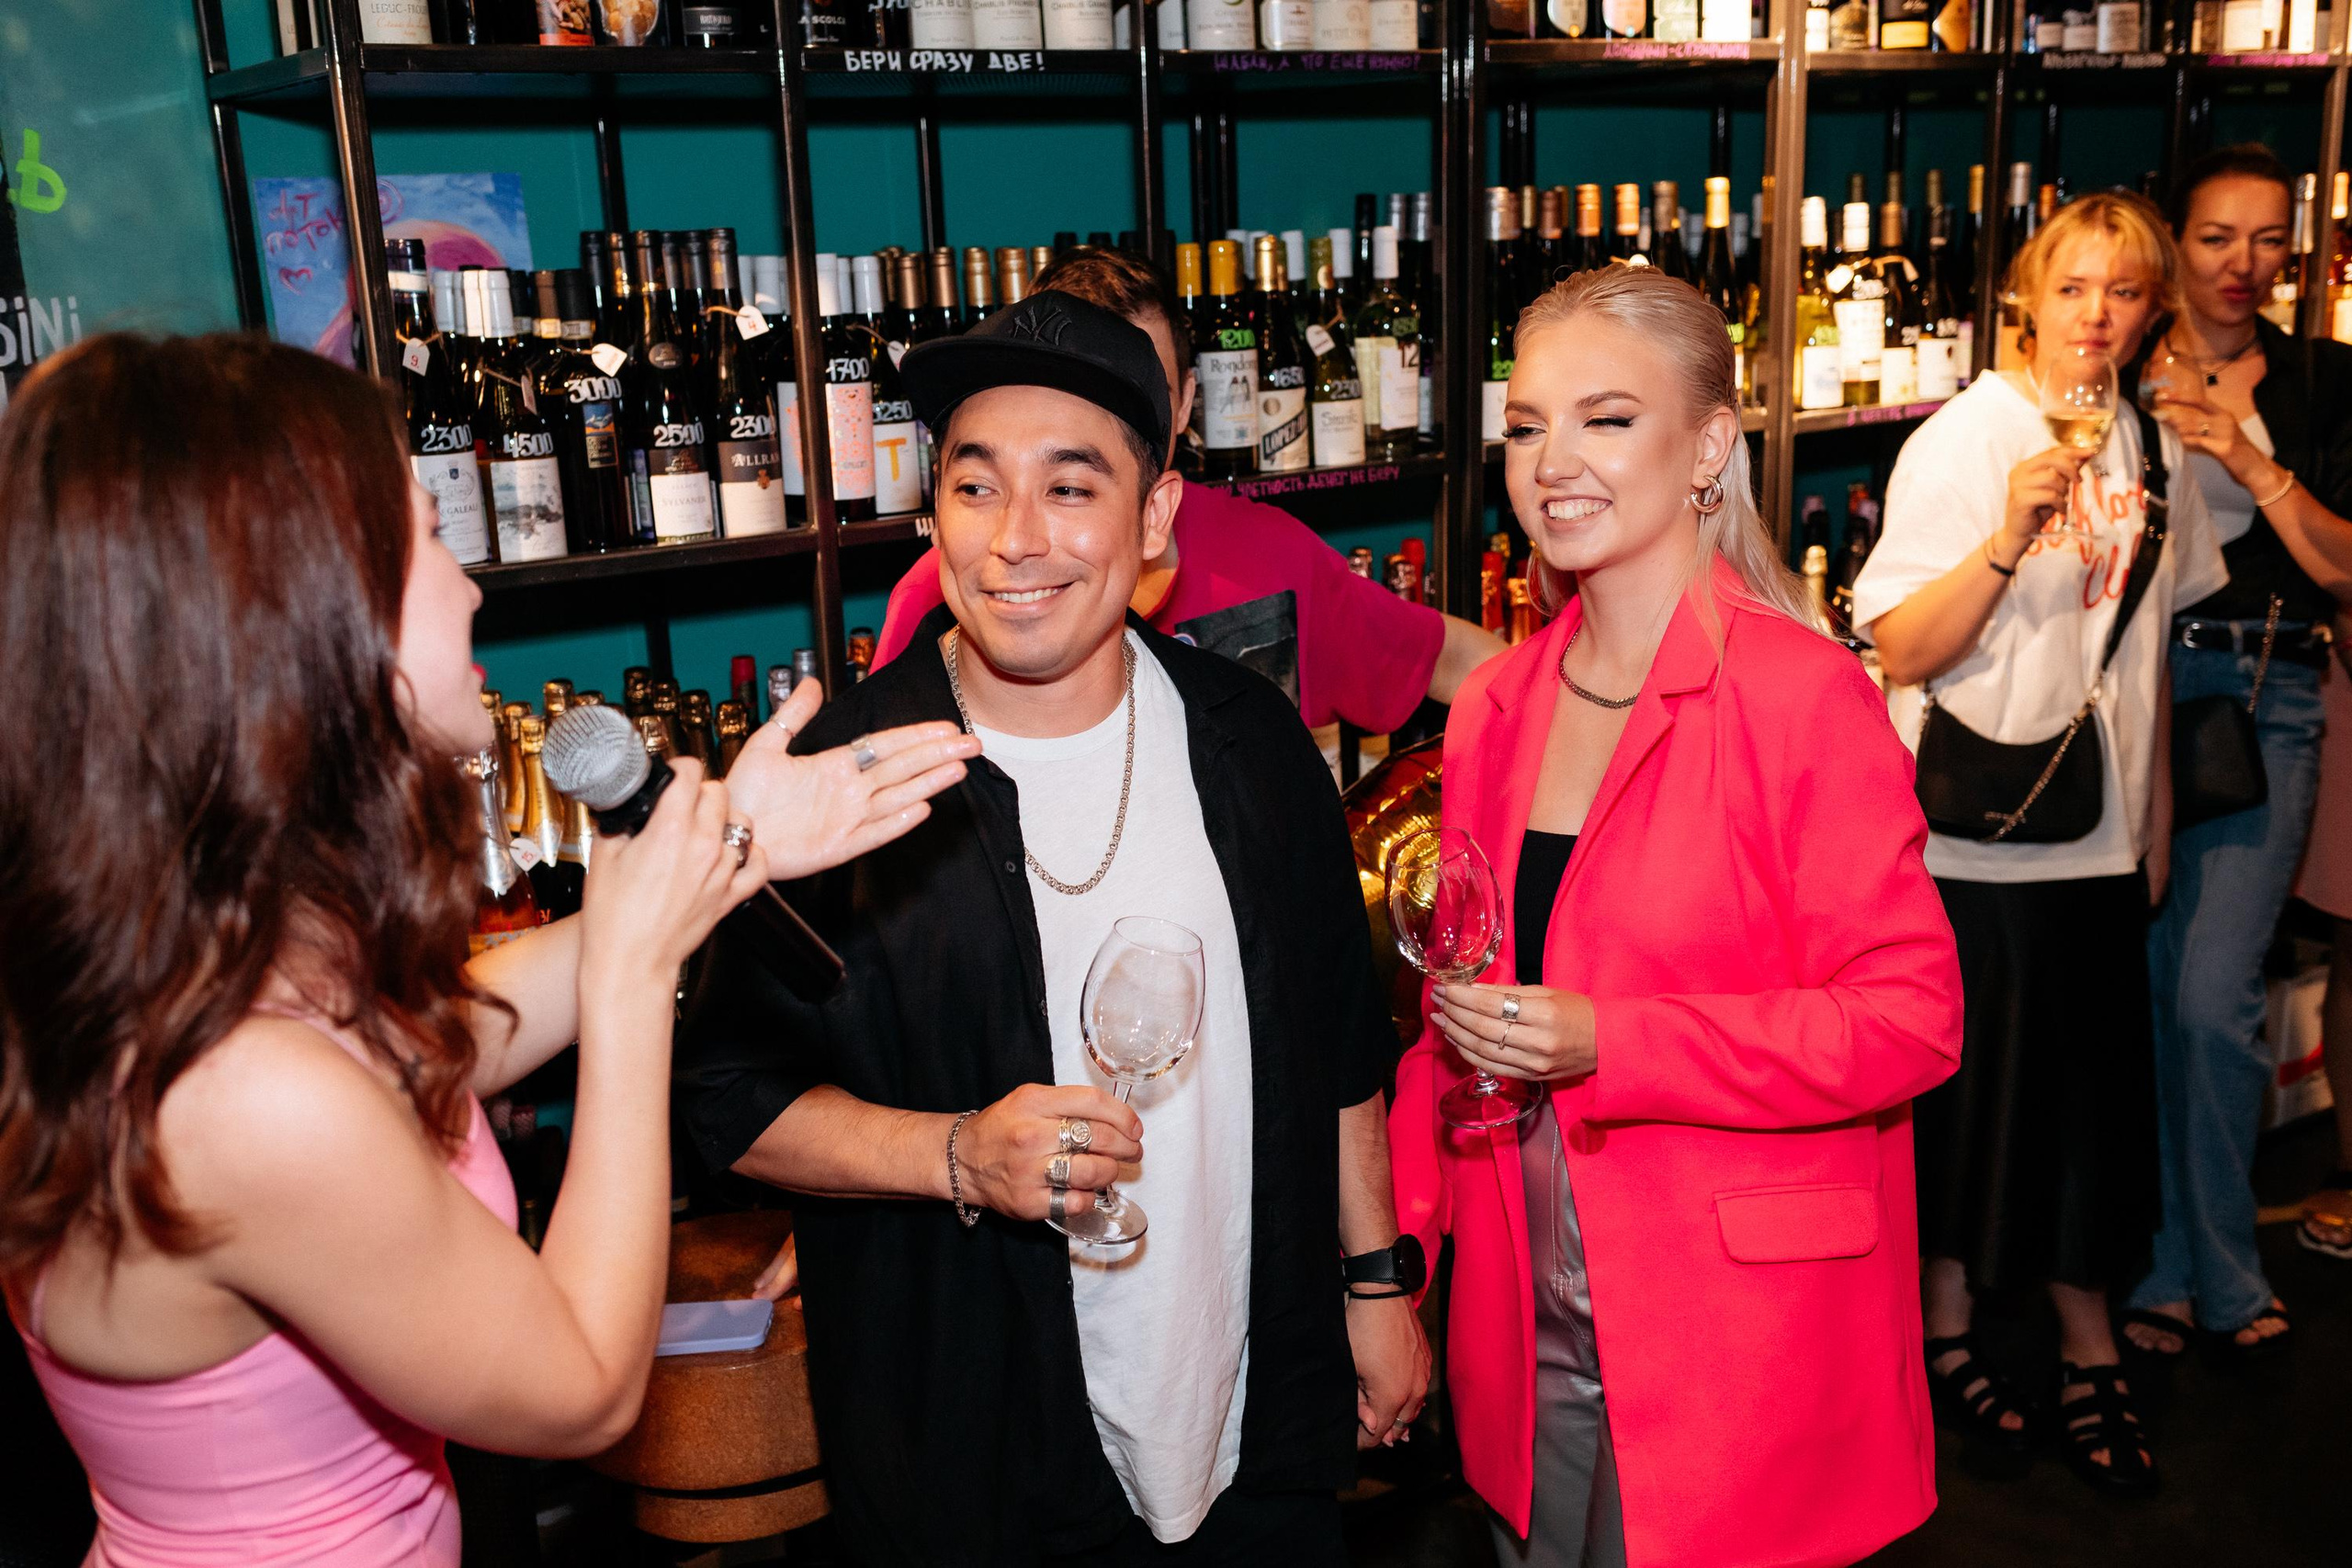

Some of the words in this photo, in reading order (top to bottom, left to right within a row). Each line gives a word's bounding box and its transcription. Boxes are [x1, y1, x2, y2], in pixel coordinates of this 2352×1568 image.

[844, 51, 901, 72] БЕРИ
[910, 51, 974, 73] СРАЗУ
[825, 357, 870, 381] 1700
[568, 376, 622, 403] 3000
[421, 423, 472, 453] 2300
[503, 432, 554, 457] 4500
[653, 422, 705, 448] 2500
